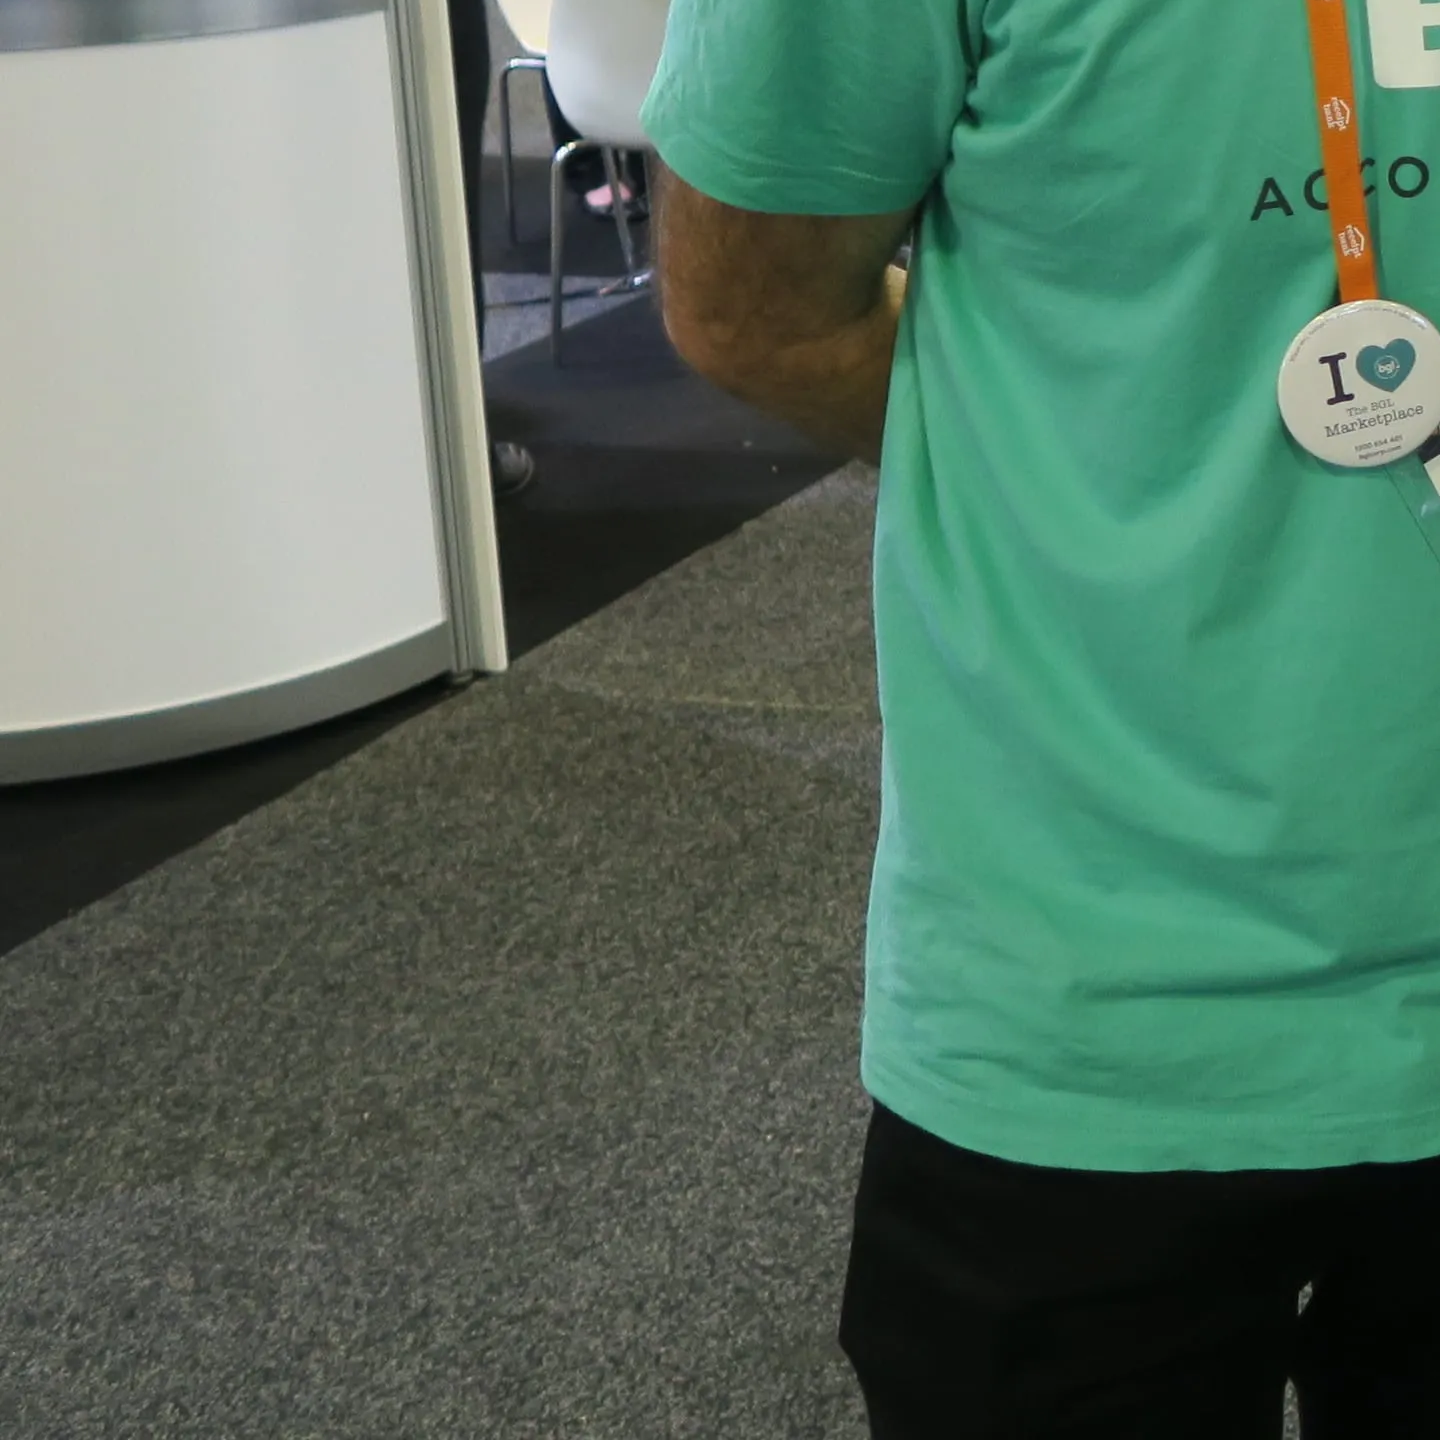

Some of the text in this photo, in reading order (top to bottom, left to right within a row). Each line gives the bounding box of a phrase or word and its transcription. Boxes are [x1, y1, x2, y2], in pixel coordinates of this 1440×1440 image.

[1319, 351, 1355, 405] I
[1324, 405, 1425, 438] Marketplace
[1346, 399, 1395, 417] The BGL
